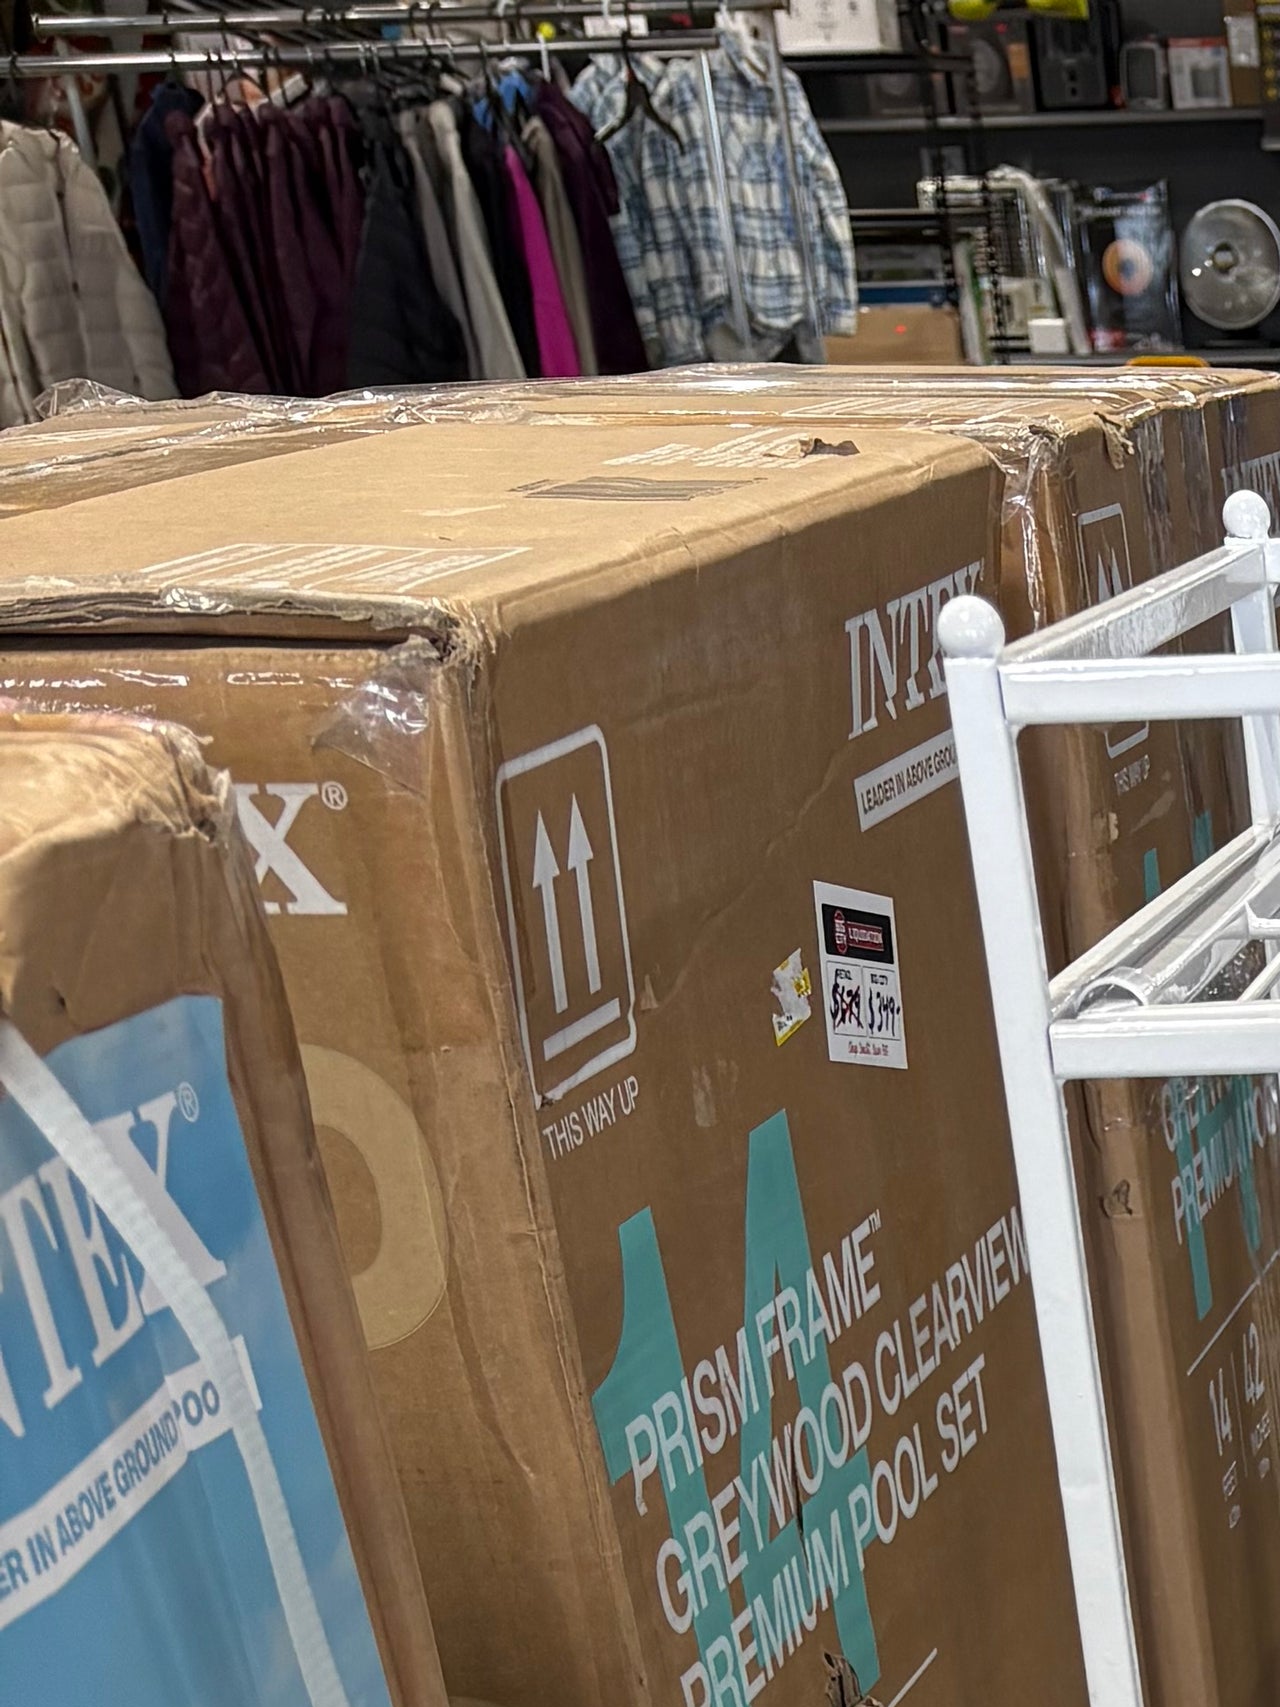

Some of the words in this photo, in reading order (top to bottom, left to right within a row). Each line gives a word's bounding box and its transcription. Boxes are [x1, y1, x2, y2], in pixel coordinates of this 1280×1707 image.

[860, 777, 895, 816] LEADER
[894, 772, 907, 797] IN
[905, 755, 935, 790] ABOVE
[932, 742, 960, 776] GROU
[542, 1112, 584, 1161] THIS
[580, 1091, 618, 1140] WAY
[616, 1075, 641, 1112] UP
[26, 1526, 59, 1577] IN
[54, 1469, 117, 1557] ABOVE
[112, 1408, 179, 1498] GROUND
[624, 1326, 761, 1517] PRISM
[656, 1360, 873, 1635] GREYWOOD
[873, 1206, 1030, 1416] CLEARVIEW
[850, 1423, 939, 1572] POOL
[936, 1352, 989, 1473] SET
